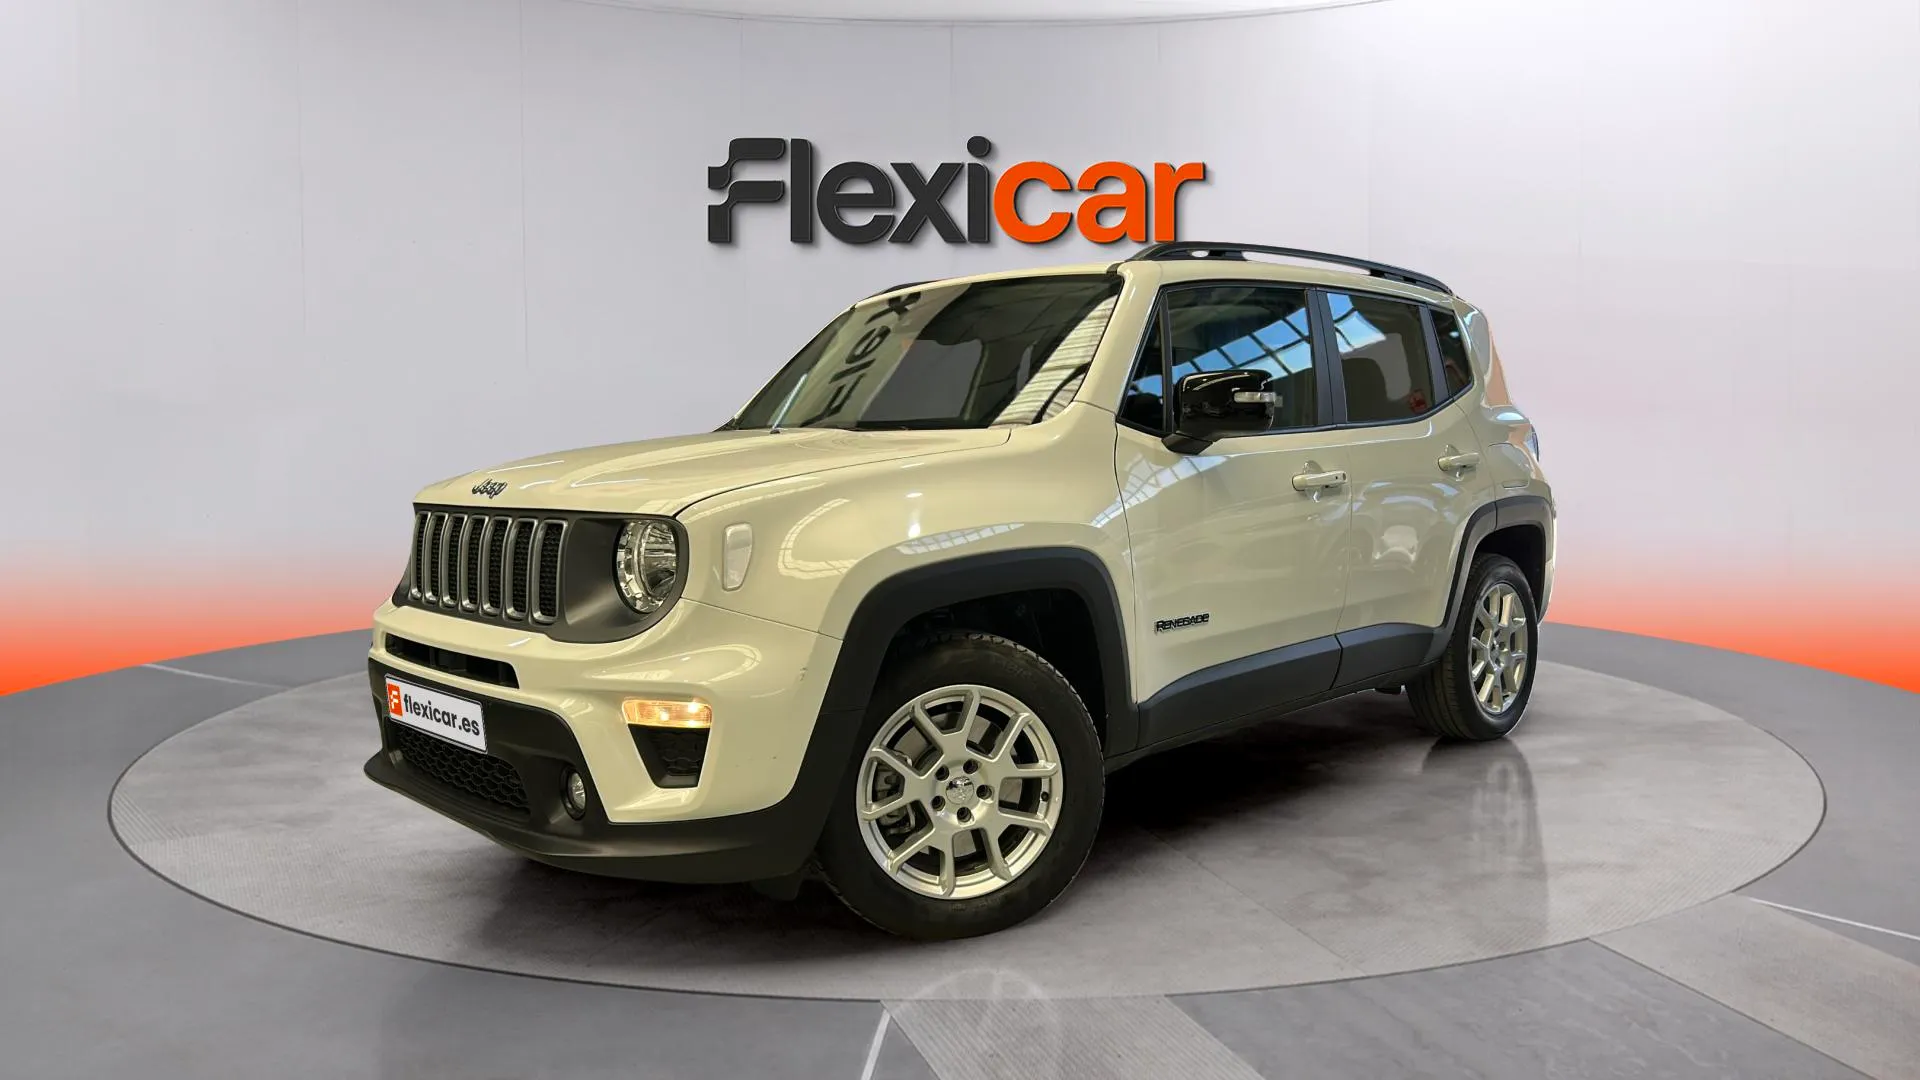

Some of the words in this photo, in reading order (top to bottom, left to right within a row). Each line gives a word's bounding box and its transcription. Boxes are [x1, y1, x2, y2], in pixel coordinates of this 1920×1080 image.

[707, 136, 1207, 244] Flexicar
[471, 478, 508, 500] Jeep
[403, 693, 480, 736] flexicar.es
